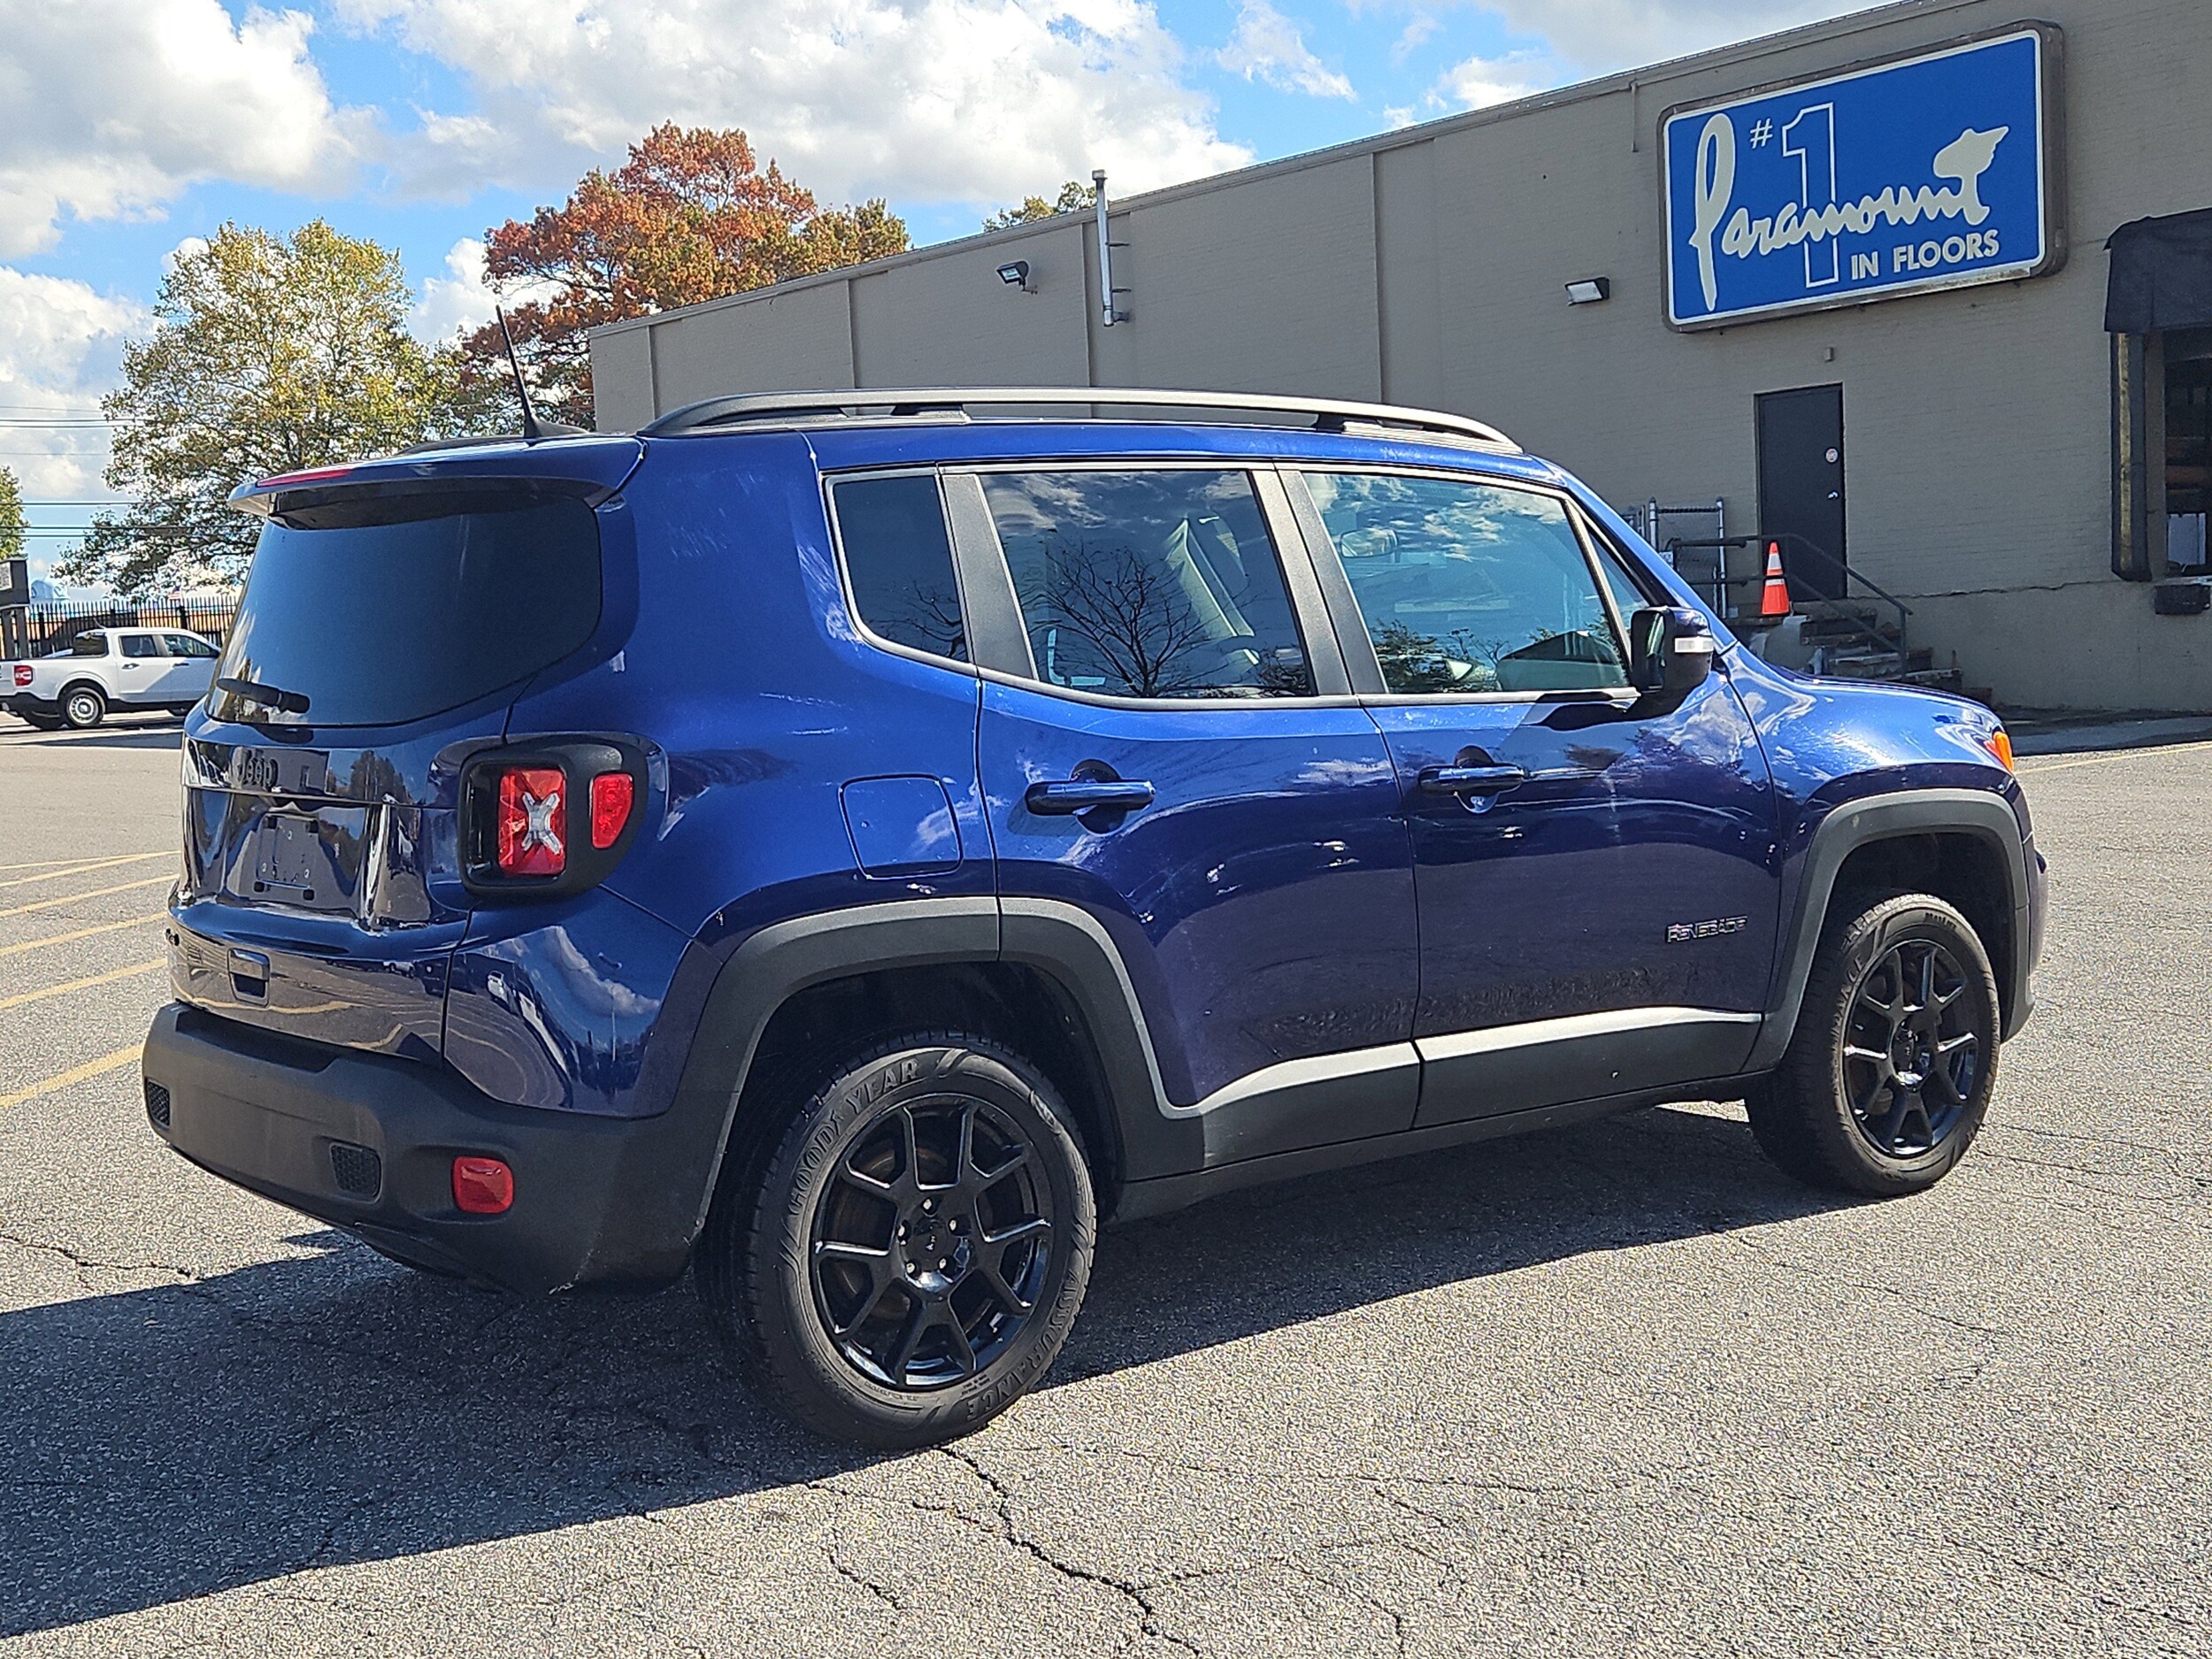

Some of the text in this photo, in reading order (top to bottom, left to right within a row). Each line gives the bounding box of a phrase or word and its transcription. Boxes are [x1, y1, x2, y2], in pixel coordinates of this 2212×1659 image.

[1688, 112, 2009, 312] Paramount
[1851, 229, 2000, 280] IN FLOORS
[1666, 915, 1748, 943] RENEGADE
[966, 1269, 1081, 1421] ASSURANCE
